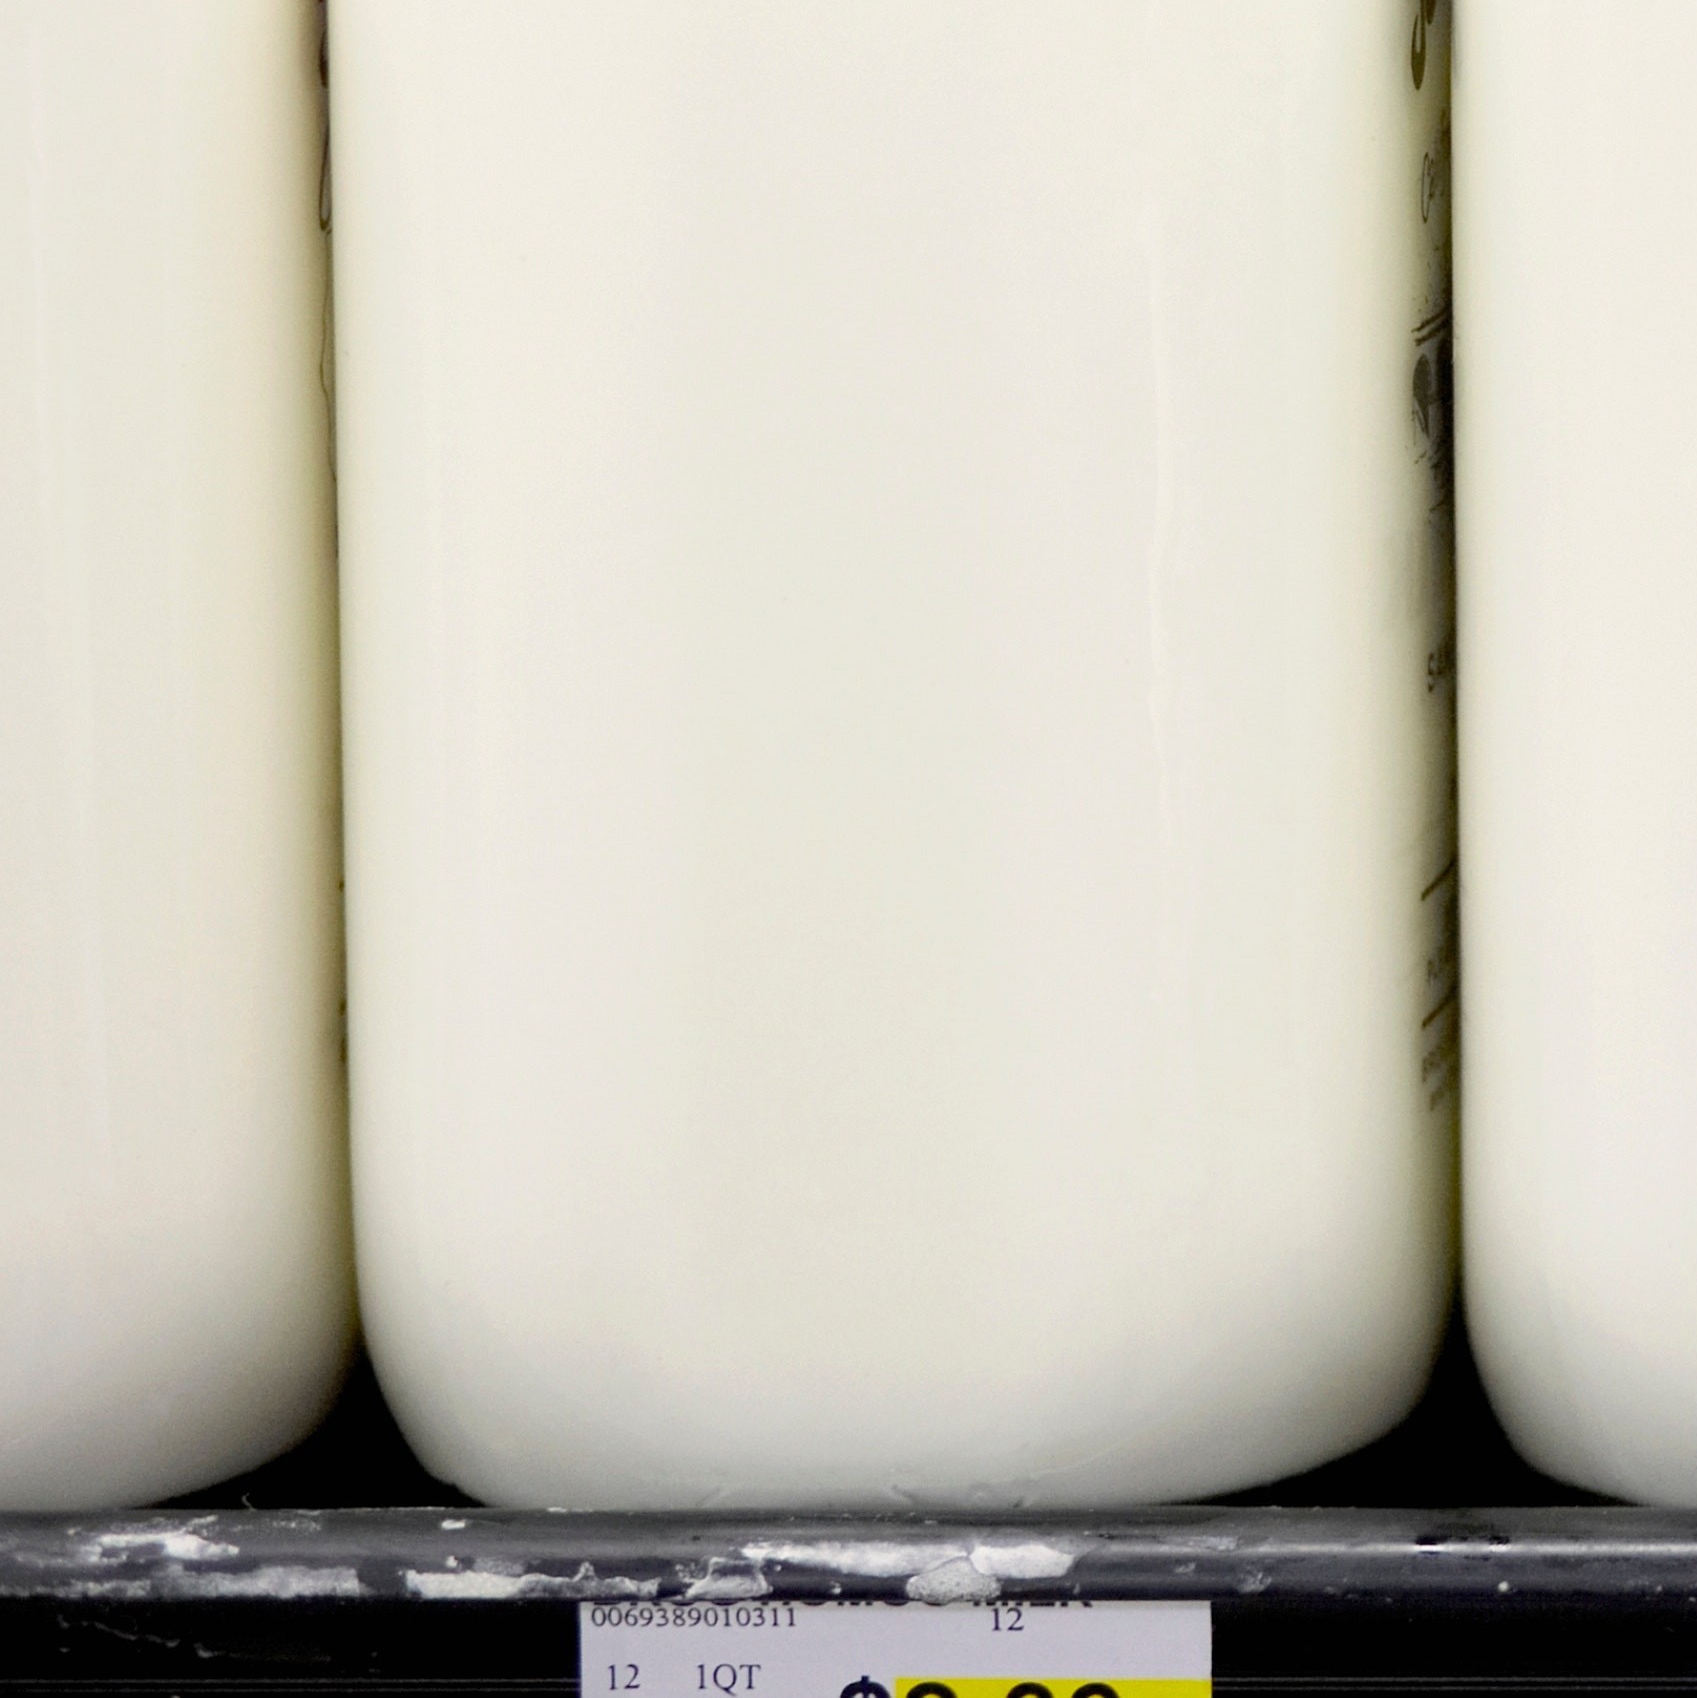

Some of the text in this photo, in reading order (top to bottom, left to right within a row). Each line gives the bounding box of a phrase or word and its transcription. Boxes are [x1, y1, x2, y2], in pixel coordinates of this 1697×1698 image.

[590, 1607, 1024, 1631] 0069389010311 12
[608, 1663, 762, 1696] 12 1QT
